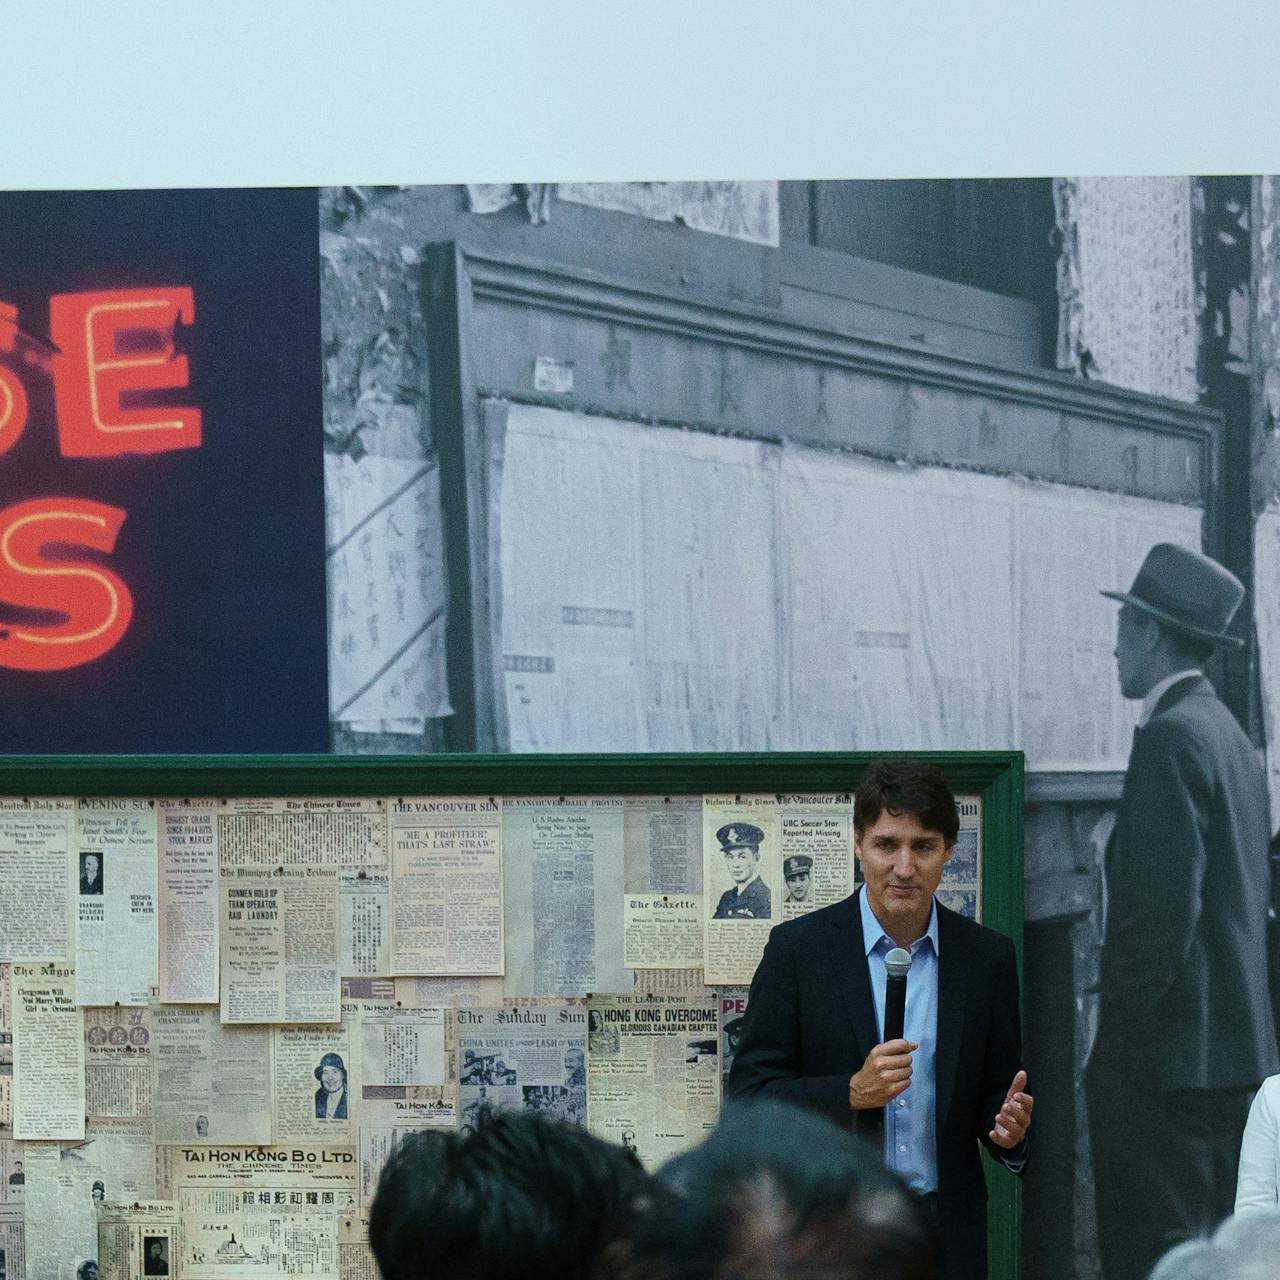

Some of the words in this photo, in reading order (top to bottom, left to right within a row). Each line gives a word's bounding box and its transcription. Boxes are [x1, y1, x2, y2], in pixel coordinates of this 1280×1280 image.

[78, 799, 127, 811] EVENING
[132, 799, 155, 811] SUN
[393, 803, 412, 813] THE
[414, 802, 477, 812] VANCOUVER
[478, 801, 499, 812] SUN
[782, 819, 799, 828] UBC
[801, 819, 823, 828] Soccer
[824, 819, 840, 828] Star
[782, 828, 814, 839] Reported
[816, 828, 842, 840] Missing
[629, 901, 649, 910] The
[457, 1010, 484, 1024] The
[495, 1010, 547, 1027] Sunday
[556, 1010, 585, 1024] Sun
[604, 1009, 631, 1023] HONG
[634, 1009, 661, 1023] KONG
[665, 1009, 718, 1023] OVERCOME
[620, 1024, 652, 1032] GLORIOUS
[653, 1023, 687, 1032] CANADIAN
[688, 1022, 718, 1032] CHAPTER
[181, 1150, 205, 1162] TAI
[208, 1150, 241, 1162] HON
[244, 1149, 288, 1162] KONG
[292, 1150, 318, 1162] BO
[321, 1151, 357, 1163] LTD.
